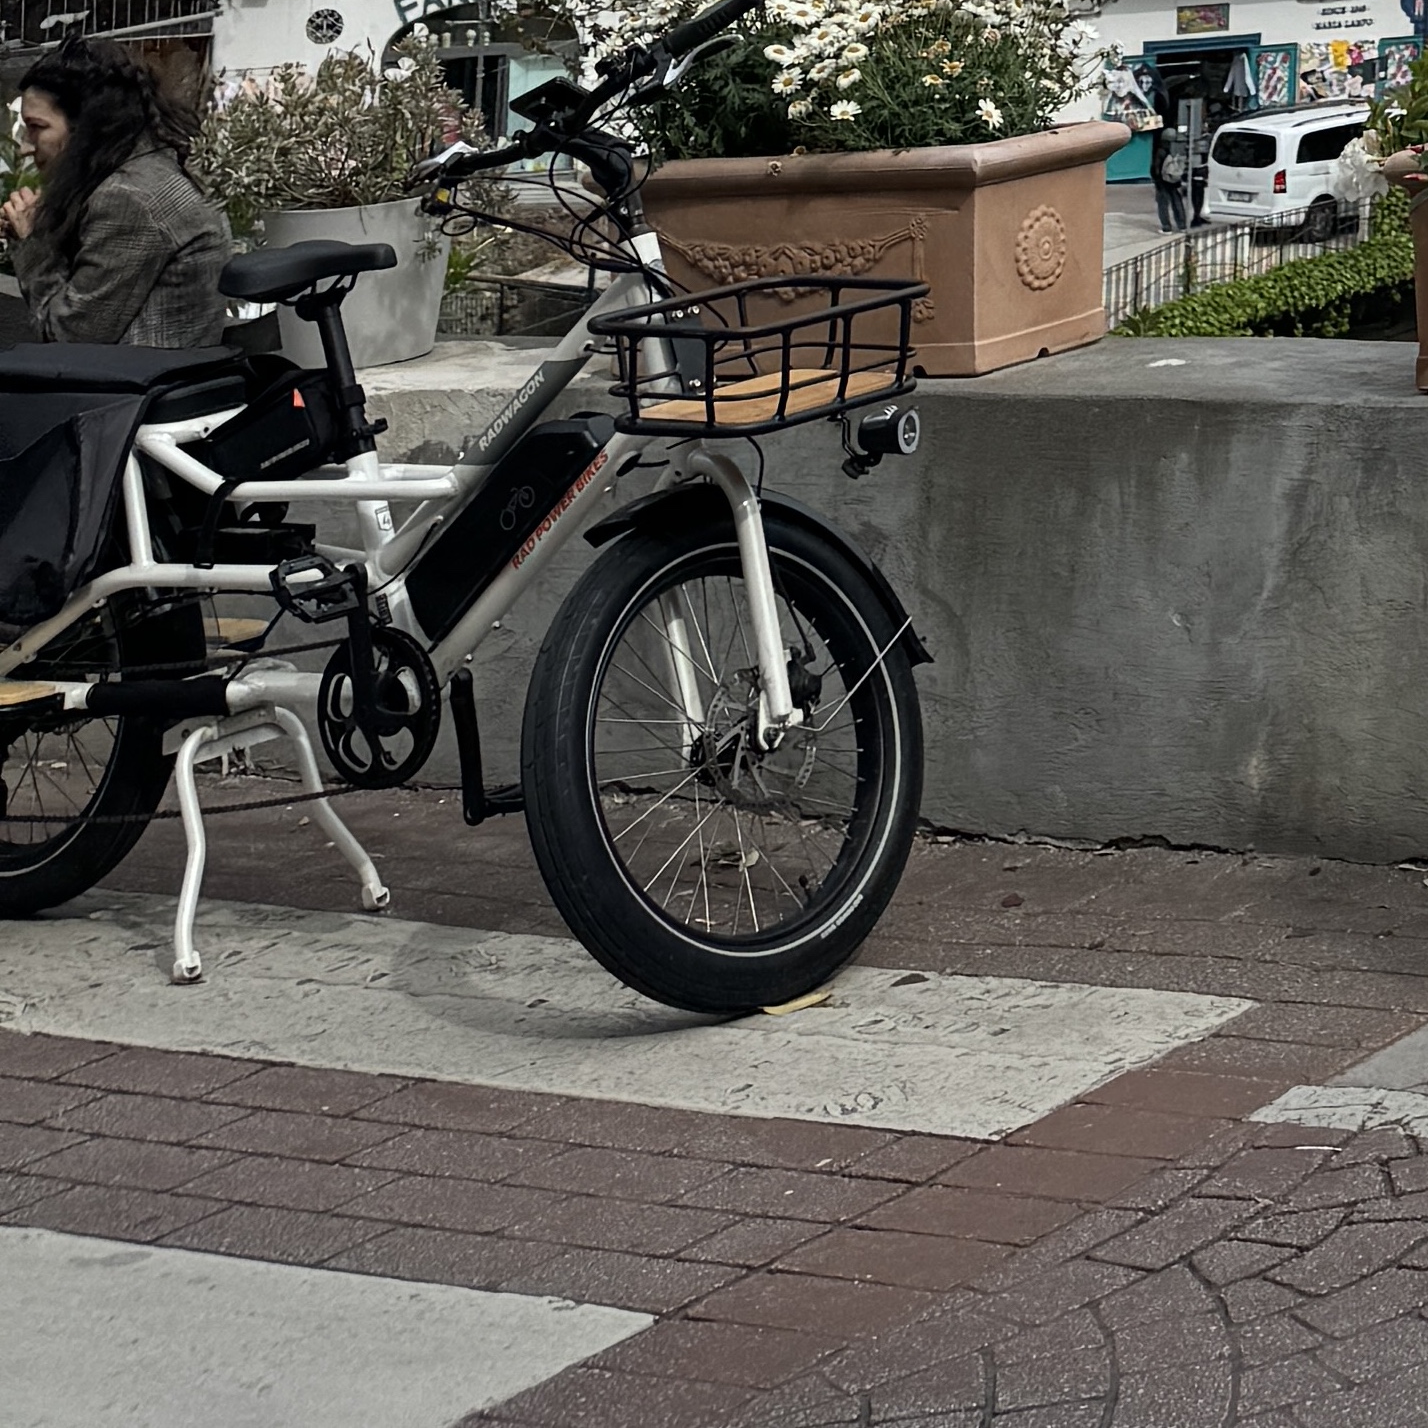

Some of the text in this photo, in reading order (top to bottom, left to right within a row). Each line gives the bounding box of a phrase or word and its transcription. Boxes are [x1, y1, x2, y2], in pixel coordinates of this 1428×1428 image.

[479, 369, 545, 452] RADWAGON
[512, 450, 608, 569] RAD POWER BIKES
